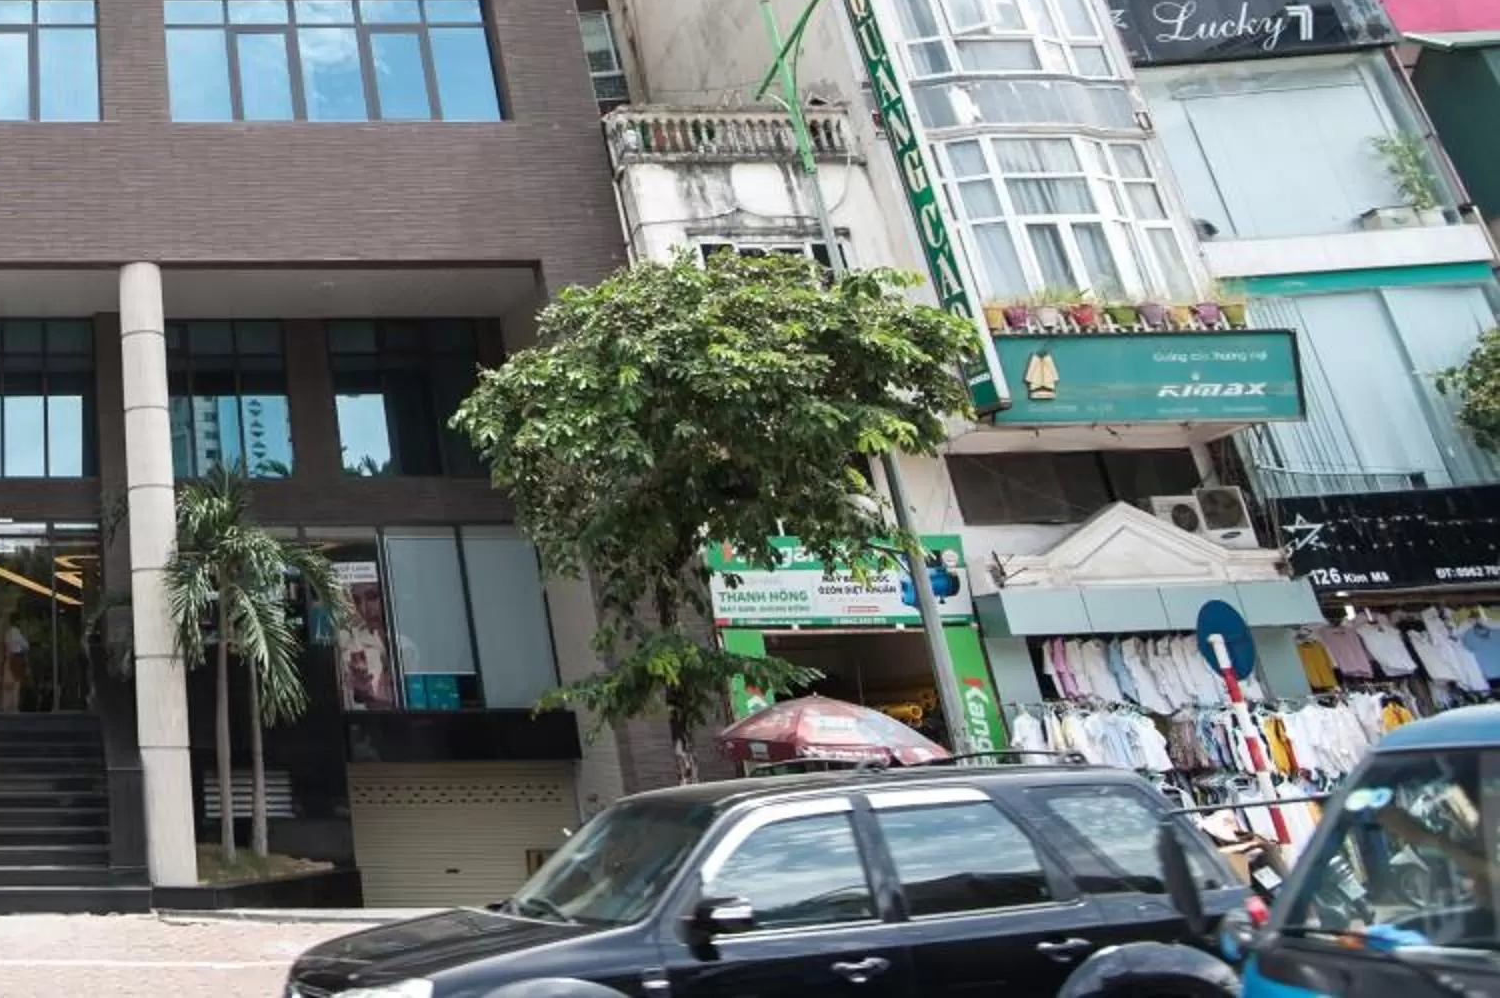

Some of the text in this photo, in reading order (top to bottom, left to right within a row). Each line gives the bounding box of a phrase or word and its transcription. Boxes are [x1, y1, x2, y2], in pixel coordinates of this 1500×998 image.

[1152, 0, 1286, 51] Lucky
[1285, 4, 1313, 42] 7
[1310, 567, 1341, 586] 126
[718, 590, 766, 603] THANH
